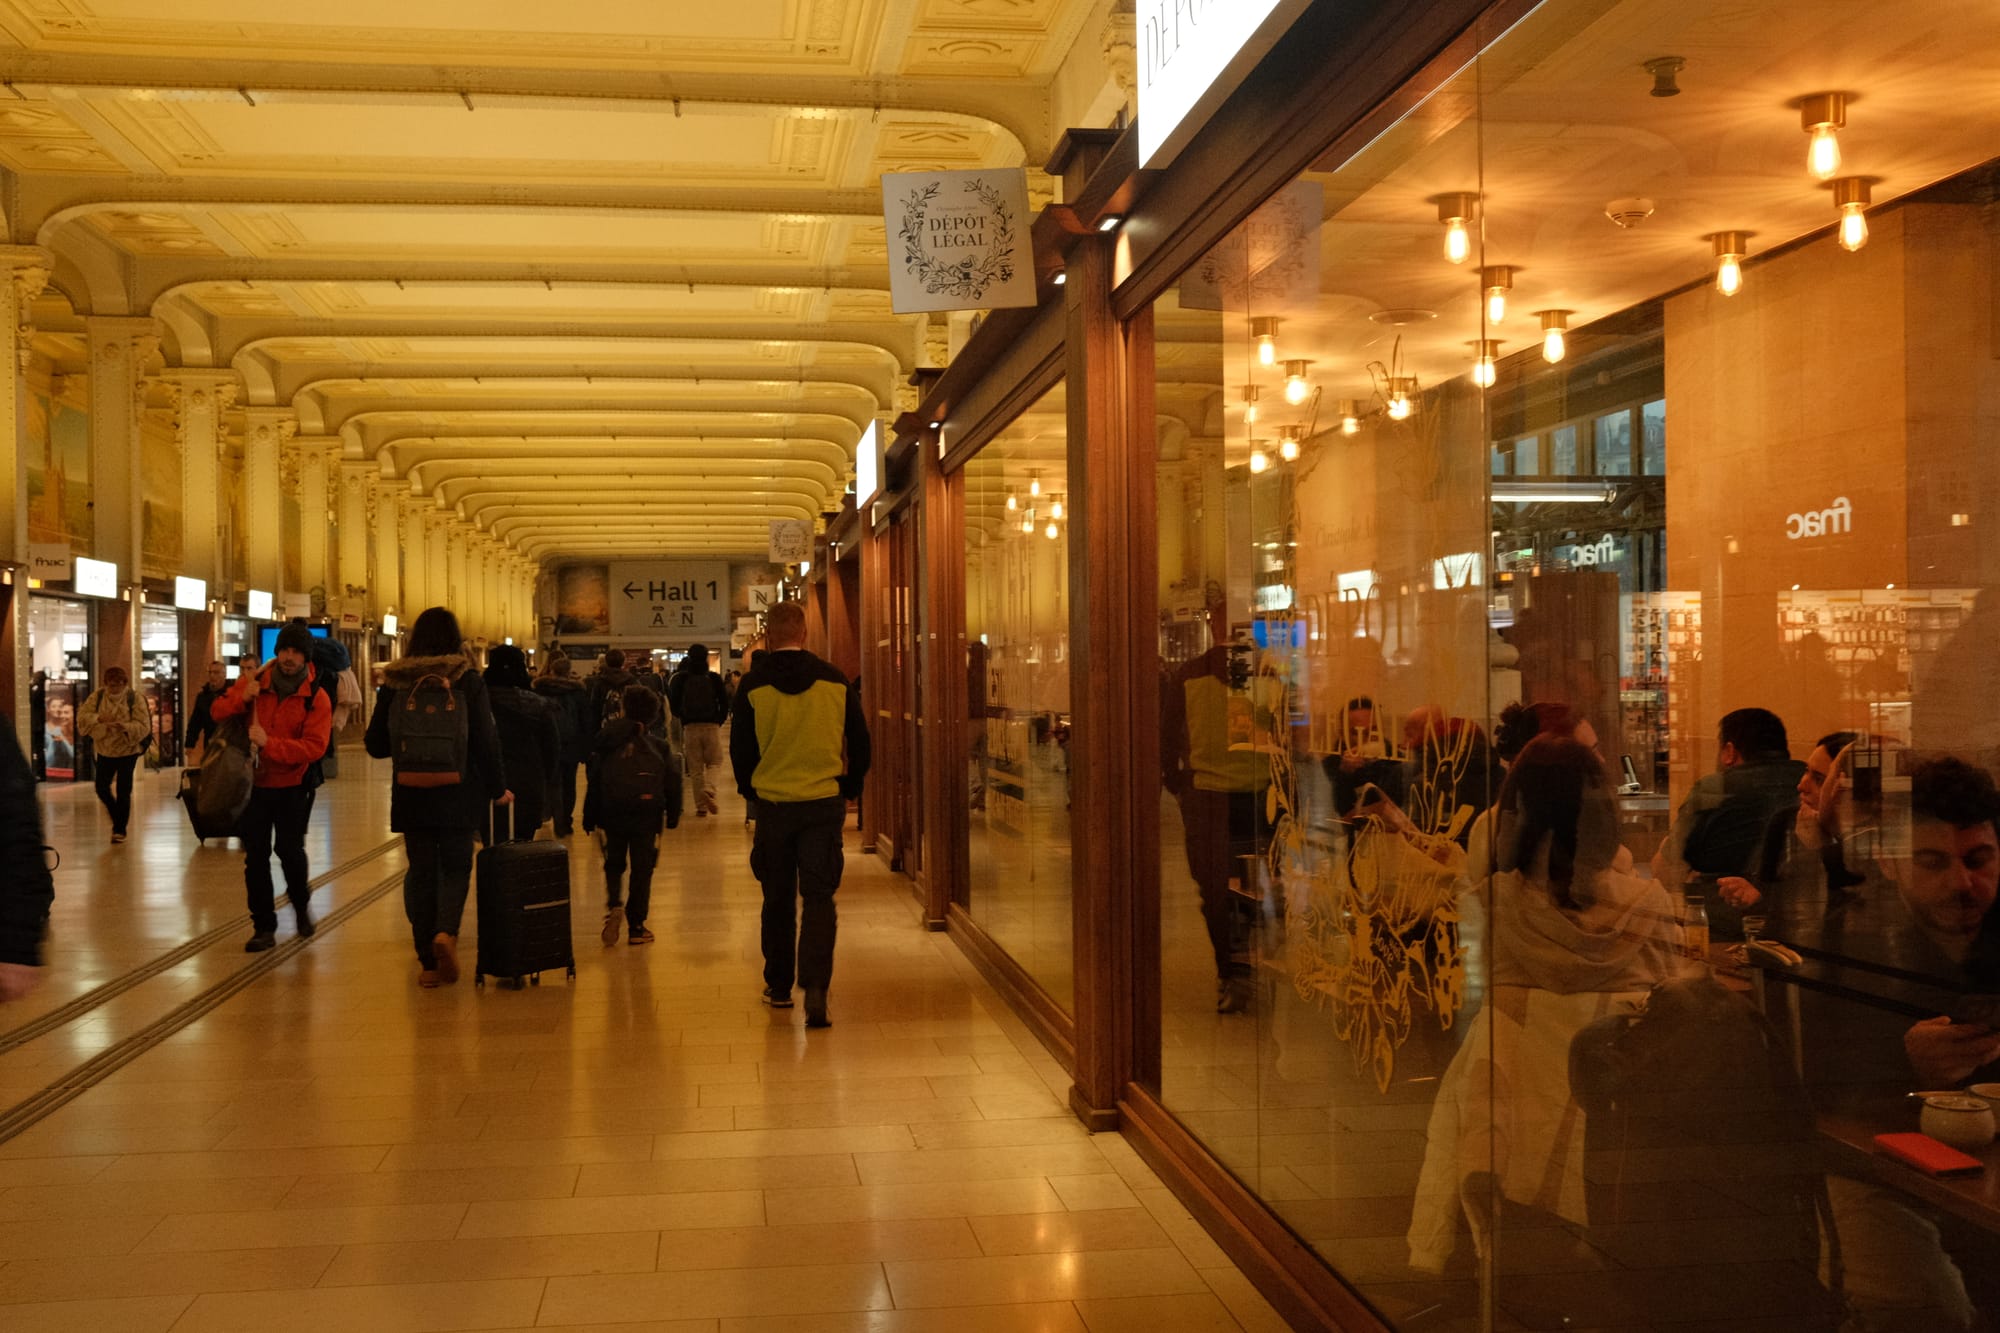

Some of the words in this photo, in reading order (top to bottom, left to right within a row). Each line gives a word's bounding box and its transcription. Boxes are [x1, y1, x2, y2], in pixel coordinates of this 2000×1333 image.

[929, 213, 987, 231] DÉPÔT
[932, 232, 989, 248] LÉGAL
[649, 580, 698, 601] Hall
[706, 580, 717, 601] 1
[652, 612, 665, 625] A
[682, 612, 694, 625] N
